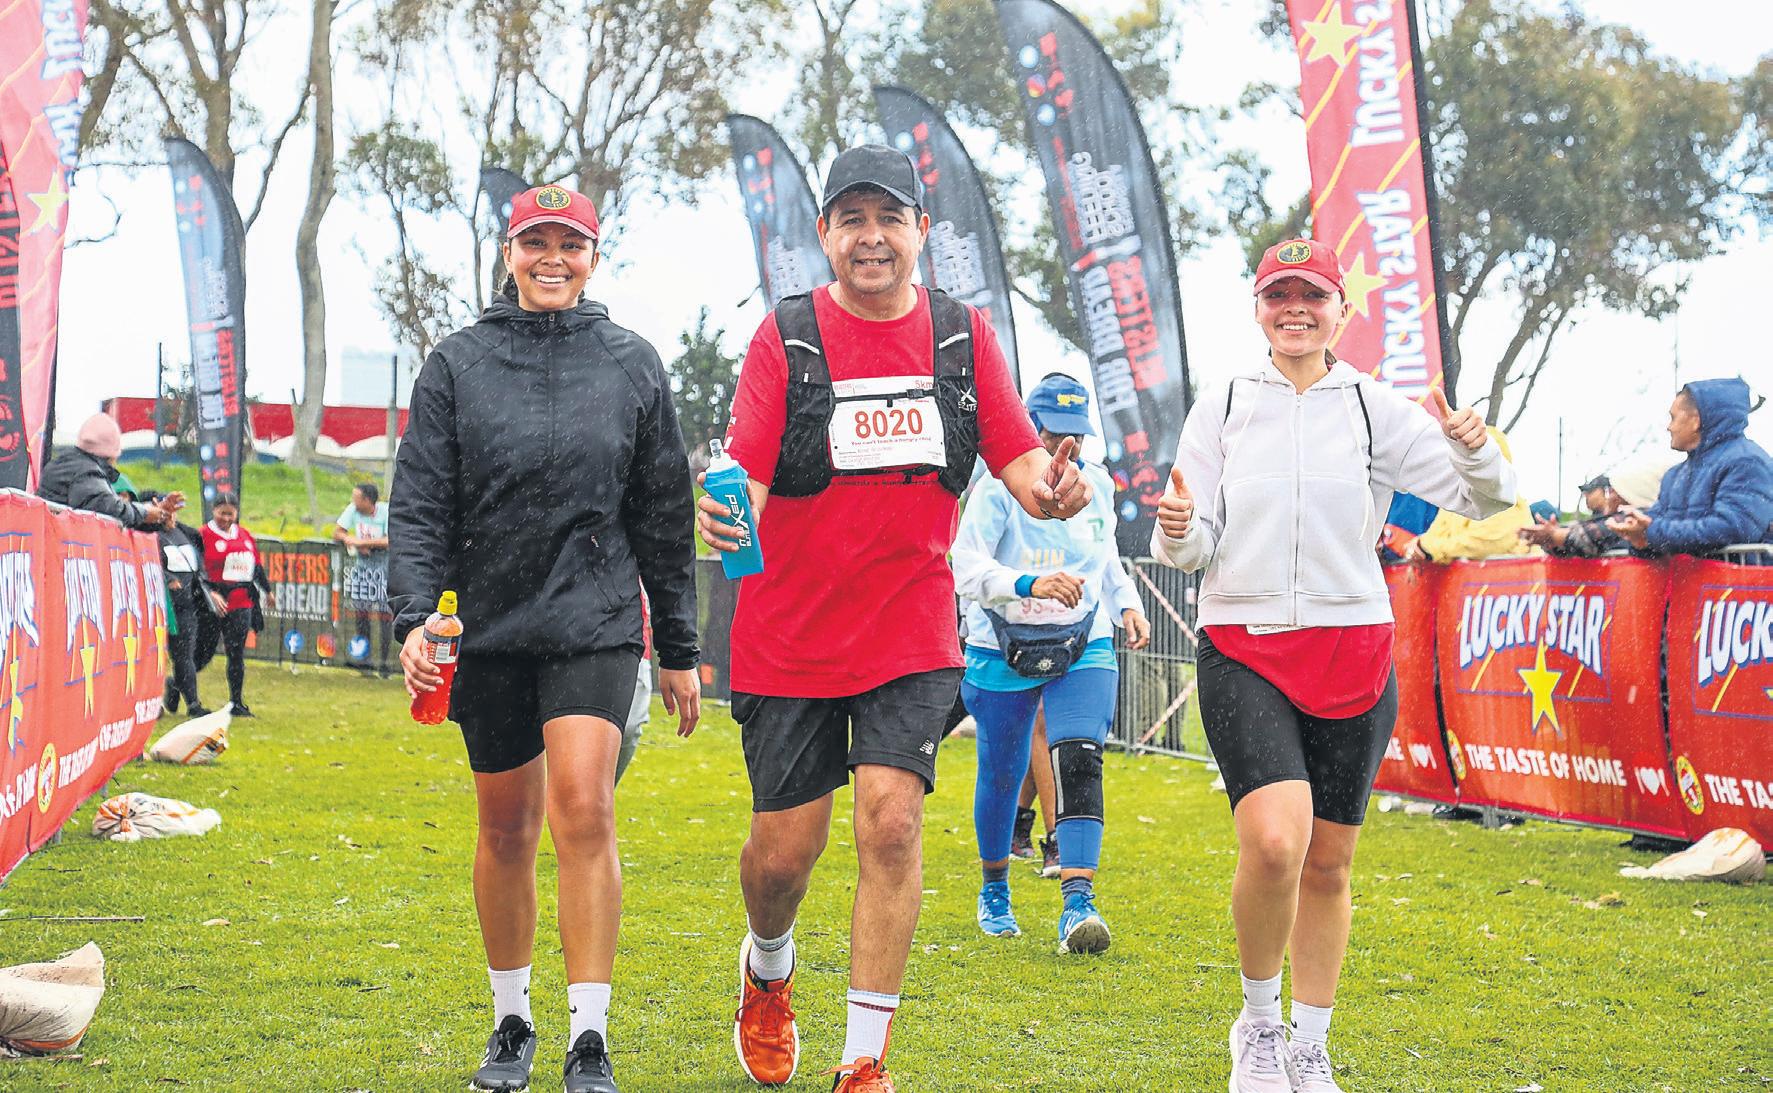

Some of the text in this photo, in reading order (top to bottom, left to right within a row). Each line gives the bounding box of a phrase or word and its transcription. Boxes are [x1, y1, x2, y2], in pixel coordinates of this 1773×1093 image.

[854, 408, 923, 439] 8020
[343, 566, 386, 583] SCHOOL
[275, 583, 328, 614] BREAD
[343, 580, 388, 602] FEEDIN
[1459, 594, 1605, 677] LUCKY STAR
[1698, 599, 1773, 686] LUCK
[1465, 743, 1496, 771] THE
[1494, 747, 1550, 776] TASTE
[1549, 751, 1570, 779] OF
[1571, 755, 1627, 786] HOME
[1704, 773, 1744, 806] THE
